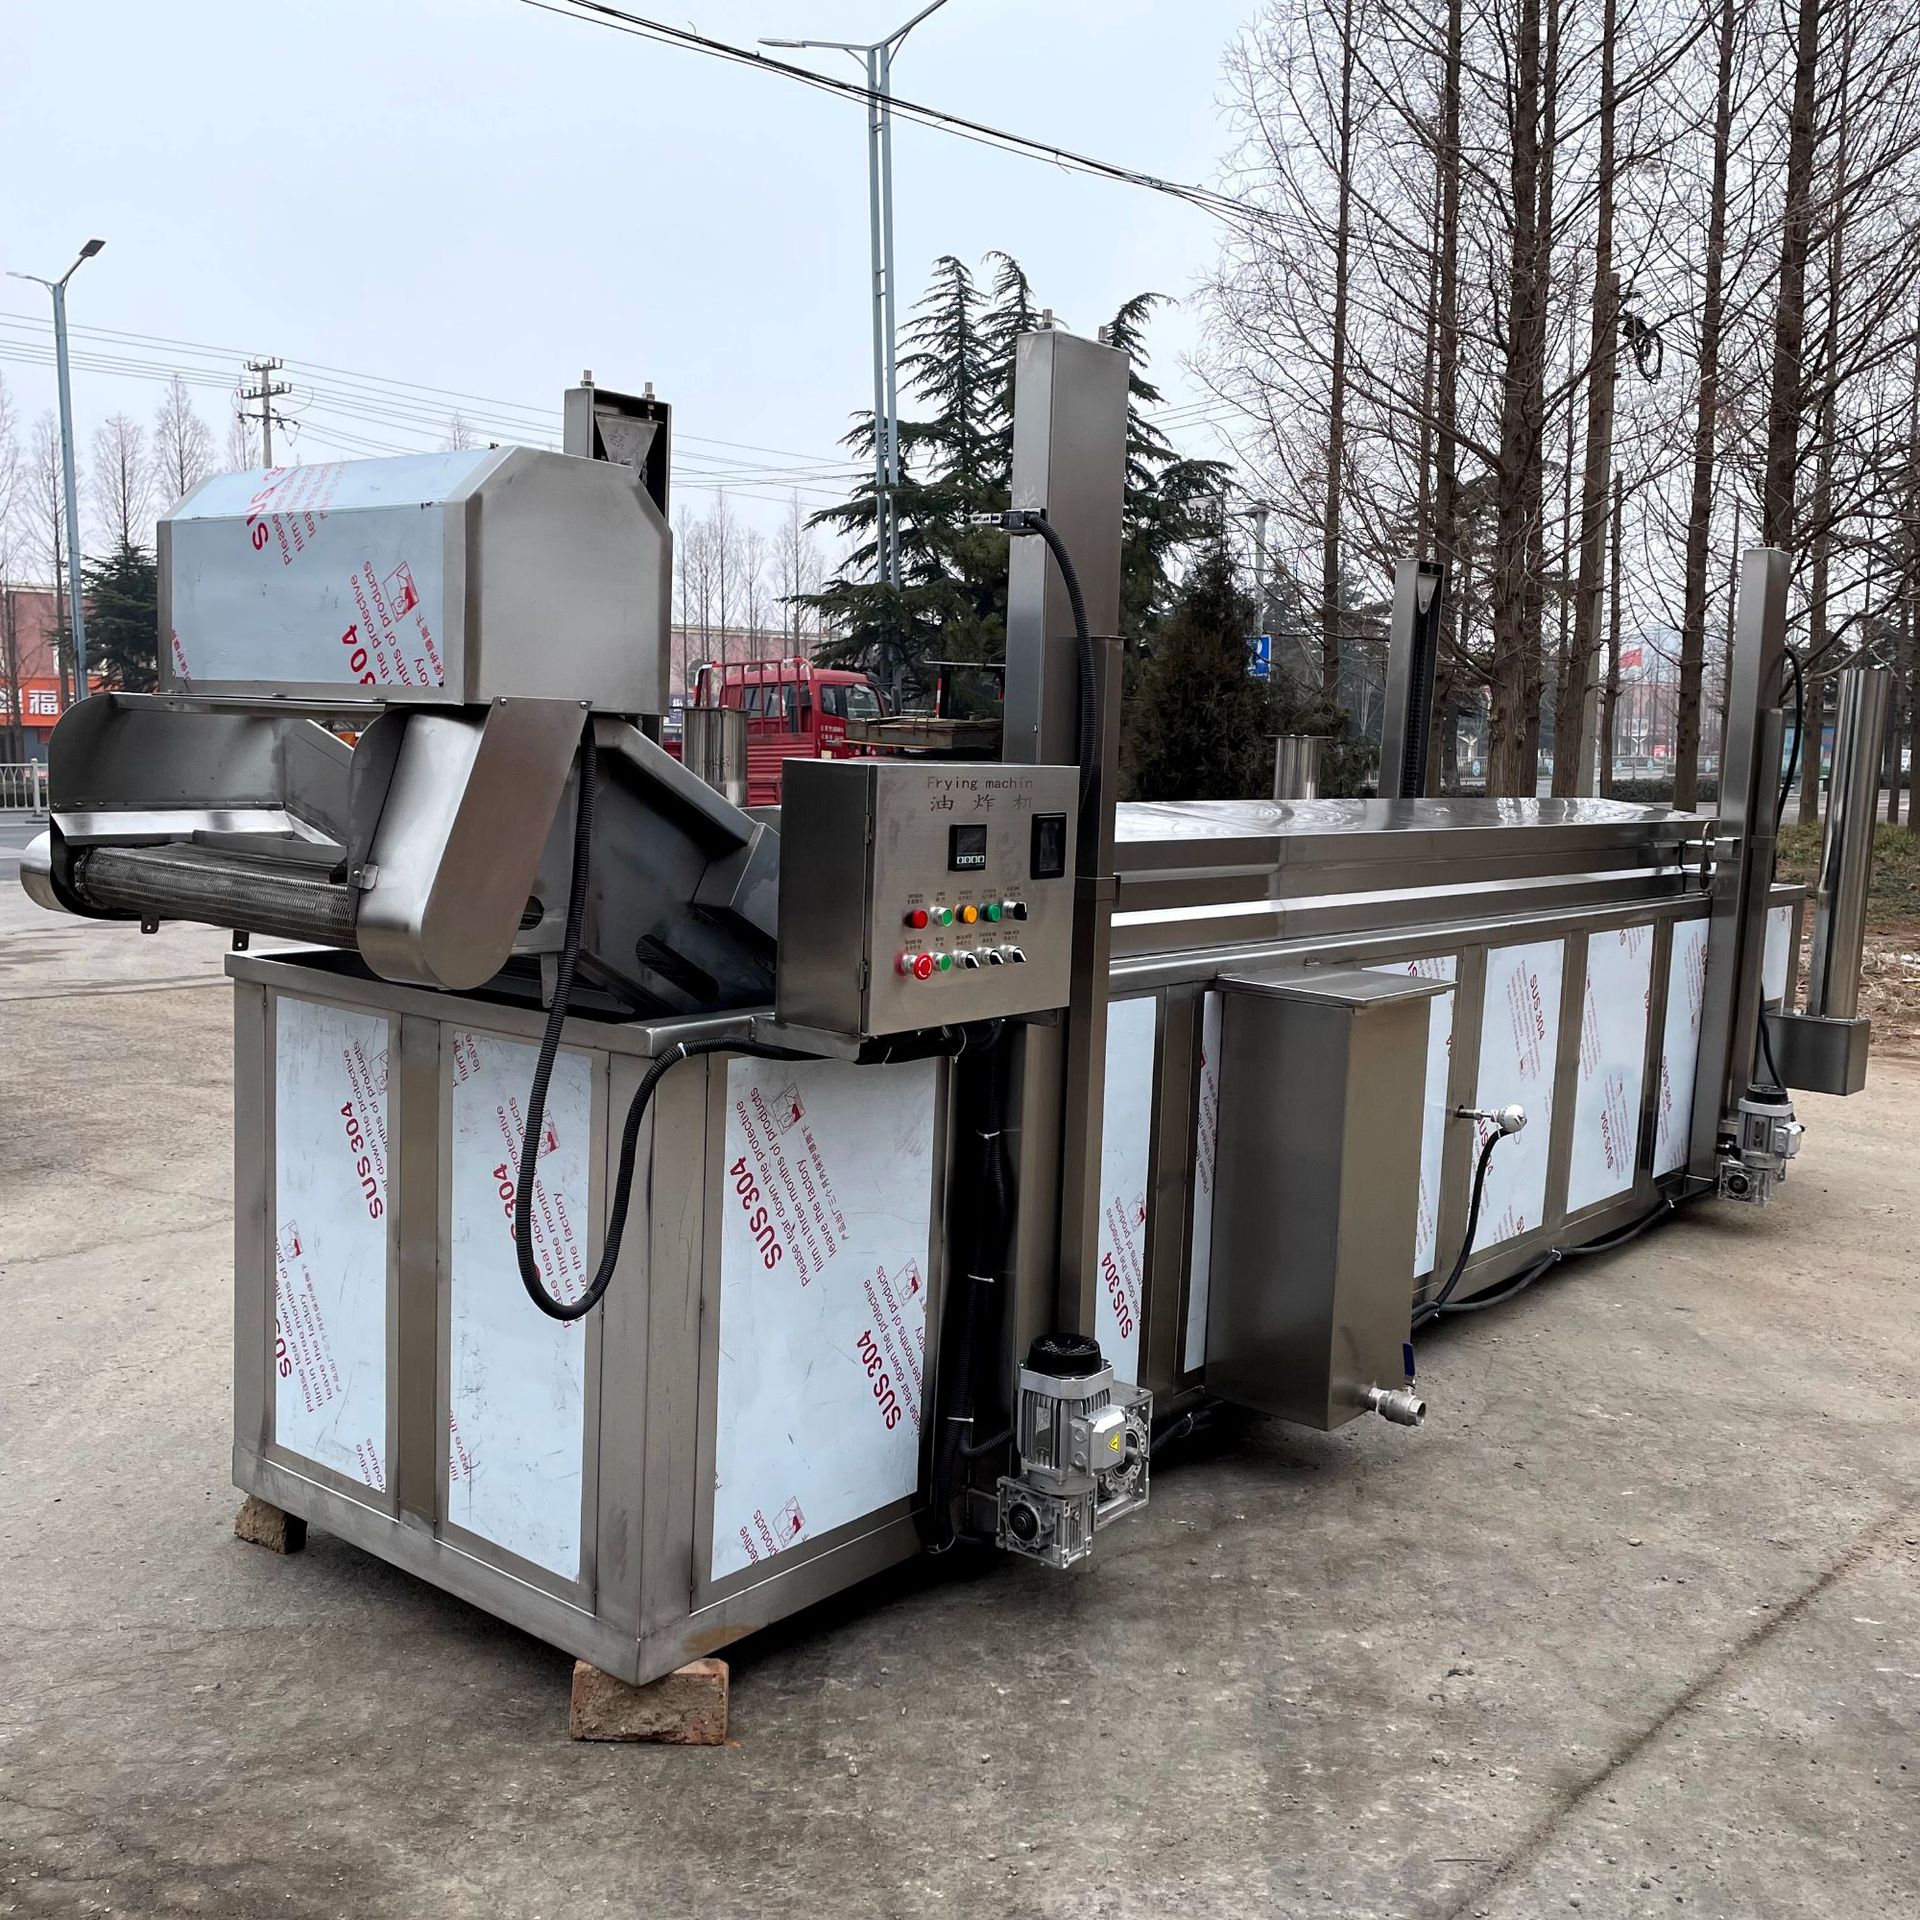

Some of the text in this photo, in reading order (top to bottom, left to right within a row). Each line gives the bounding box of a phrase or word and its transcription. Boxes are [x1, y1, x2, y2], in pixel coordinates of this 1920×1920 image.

[272, 513, 292, 566] Please
[291, 522, 304, 551] film
[364, 561, 392, 628] products
[351, 575, 389, 679] the protective
[384, 631, 396, 646] of
[927, 776, 1033, 790] Frying machin
[1530, 974, 1545, 1040] SUS 304
[354, 1041, 376, 1098] products
[465, 1033, 480, 1073] leave
[344, 1050, 367, 1113] protective
[364, 1115, 373, 1137] the
[369, 1101, 378, 1113] of
[341, 1101, 383, 1219] SUS 304
[370, 1139, 384, 1175] down
[736, 1101, 811, 1287] Please tear down the protective
[751, 1087, 825, 1272] film in three months of products
[535, 1180, 556, 1233] months
[730, 1156, 782, 1269] SUS 304
[796, 1159, 836, 1258] leave the factory
[1115, 1197, 1131, 1239] products
[553, 1193, 581, 1270] the factory
[1106, 1208, 1124, 1255] protective
[1125, 1239, 1133, 1249] of
[279, 1267, 288, 1279] of
[540, 1248, 553, 1277] tear
[552, 1237, 568, 1277] three
[1120, 1256, 1128, 1273] the
[285, 1281, 302, 1329] months
[565, 1278, 574, 1293] in
[877, 1266, 899, 1314] products
[1101, 1252, 1132, 1339] SUS 304
[1125, 1272, 1135, 1298] down
[280, 1303, 293, 1337] down
[864, 1279, 889, 1333] protective
[891, 1314, 901, 1326] of
[290, 1342, 301, 1366] tear
[299, 1294, 333, 1400] leave the factory
[299, 1331, 312, 1365] three
[883, 1333, 894, 1353] the
[898, 1326, 916, 1367] months
[309, 1368, 316, 1380] in
[857, 1330, 901, 1430] SUS 304
[890, 1352, 904, 1382] down
[298, 1368, 314, 1413] Please
[313, 1383, 323, 1407] film
[901, 1383, 912, 1405] tear
[740, 1526, 760, 1566] tective
